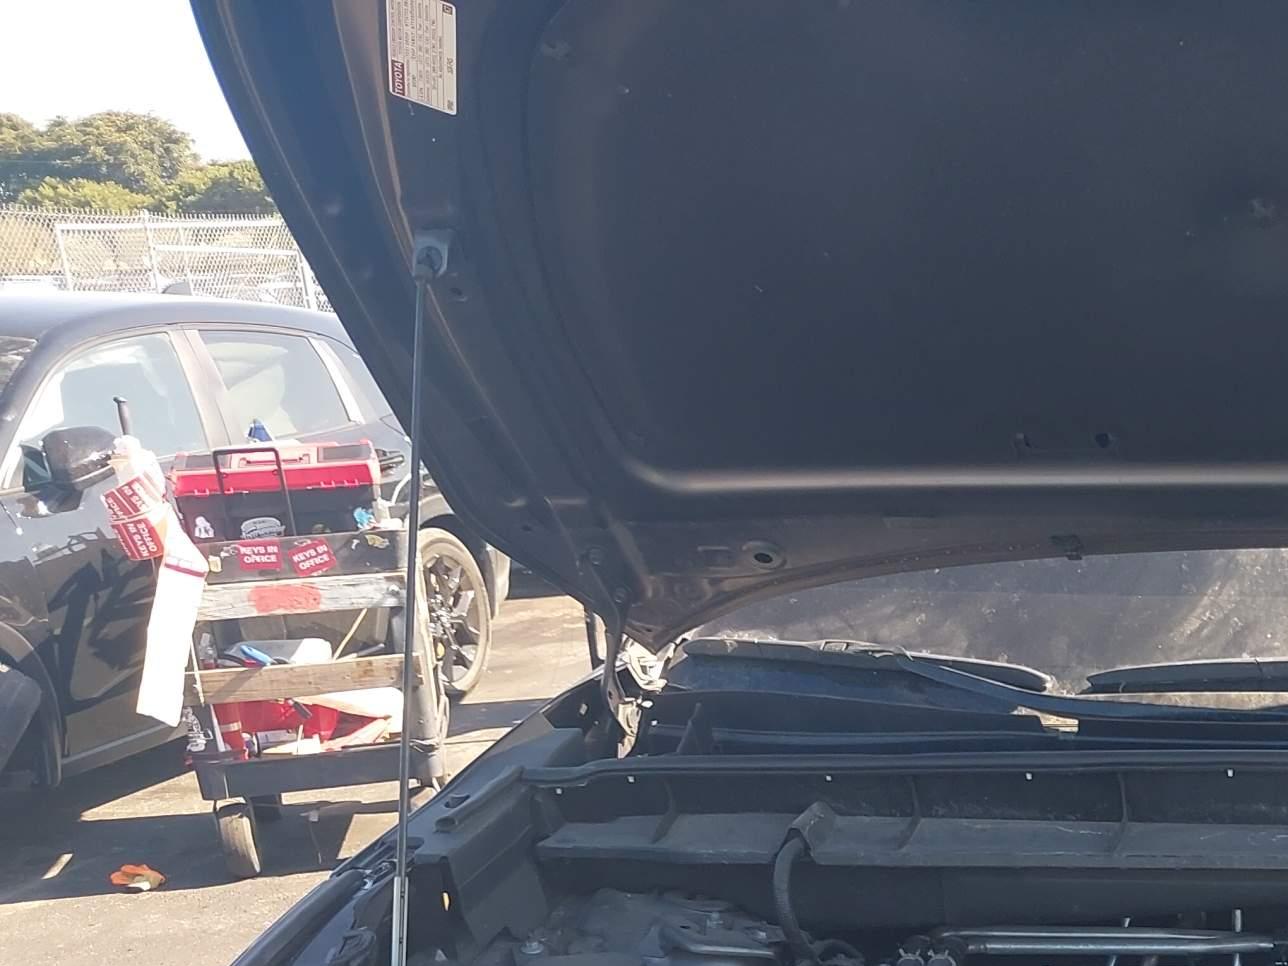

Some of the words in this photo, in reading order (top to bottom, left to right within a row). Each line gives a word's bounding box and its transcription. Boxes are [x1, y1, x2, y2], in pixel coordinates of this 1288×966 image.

[394, 62, 403, 95] TOYOTA
[136, 522, 157, 552] OFFICE
[240, 546, 265, 555] KEYS
[267, 545, 279, 553] IN
[243, 554, 277, 563] OFFICE
[292, 549, 316, 562] KEYS
[317, 544, 328, 553] IN
[299, 554, 330, 570] OFFICE
